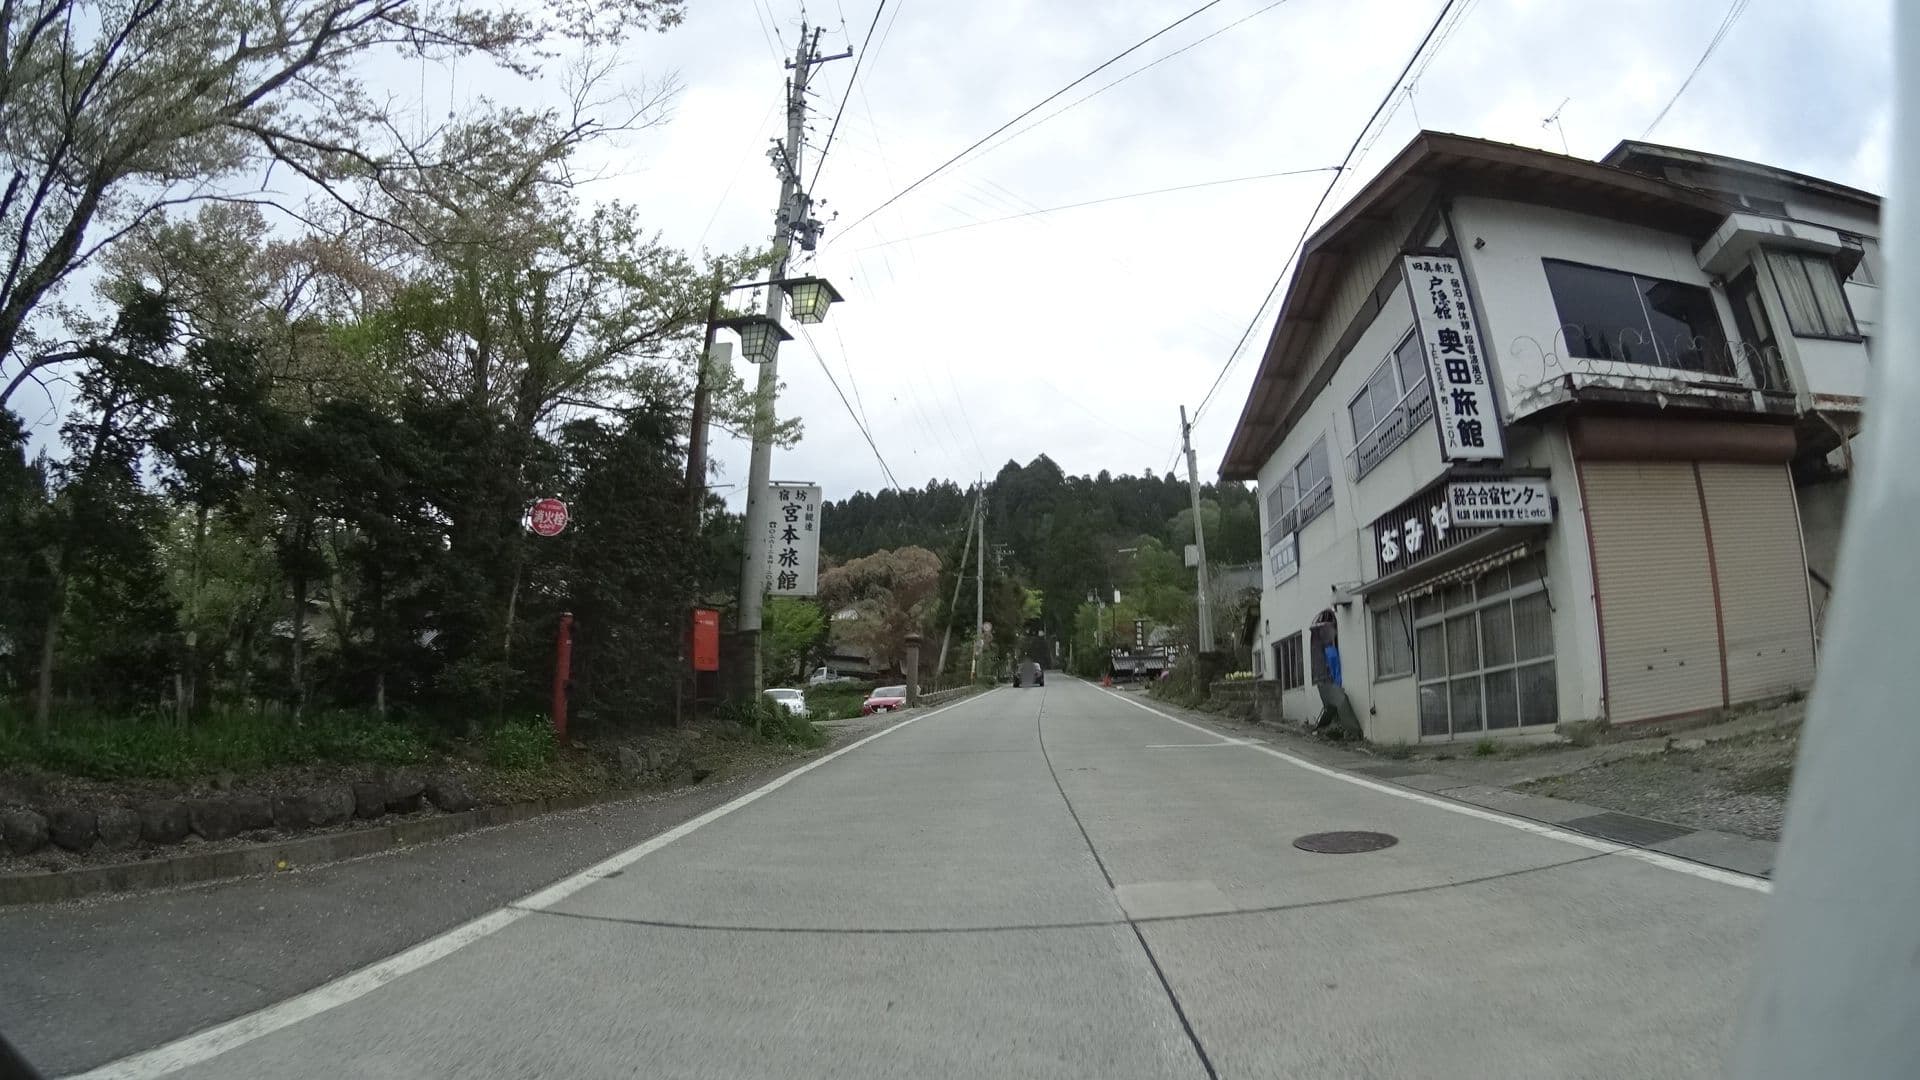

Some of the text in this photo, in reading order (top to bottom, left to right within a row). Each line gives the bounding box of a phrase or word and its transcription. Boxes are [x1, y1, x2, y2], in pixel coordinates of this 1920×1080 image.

[1437, 327, 1485, 448] 奥田旅館
[1453, 485, 1544, 508] 総合合宿センター
[777, 502, 803, 592] 宮本旅館
